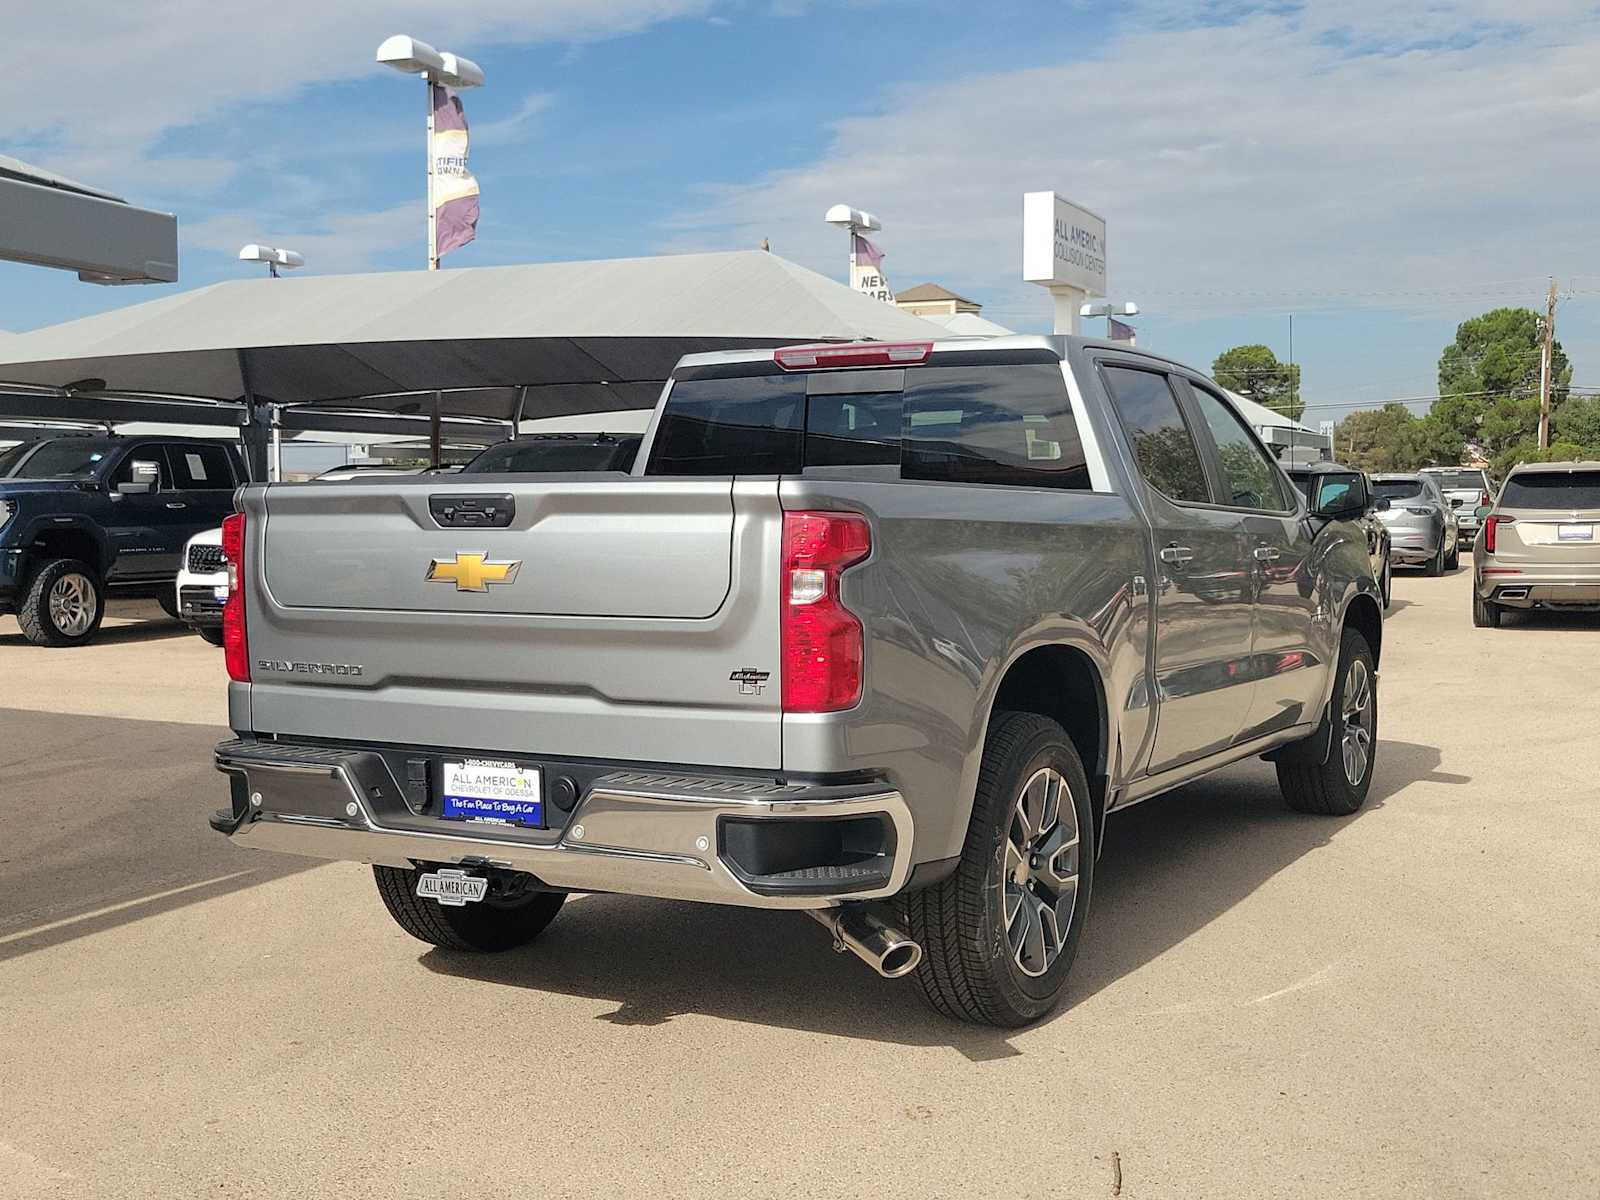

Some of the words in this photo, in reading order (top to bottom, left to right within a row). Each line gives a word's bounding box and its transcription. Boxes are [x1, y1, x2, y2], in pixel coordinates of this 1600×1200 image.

[1054, 218, 1069, 241] ALL
[861, 290, 894, 302] ARS
[258, 660, 363, 676] SILVERADO
[738, 682, 767, 696] LT
[452, 773, 473, 785] ALL
[450, 783, 491, 795] CHEVROLET
[493, 787, 504, 796] OF
[504, 788, 536, 798] ODESSA
[450, 798, 463, 808] The
[476, 800, 493, 810] Place
[493, 801, 502, 811] To
[515, 803, 522, 811] A
[523, 804, 536, 814] Car
[424, 880, 438, 892] ALL
[440, 880, 479, 896] AMERICAN
